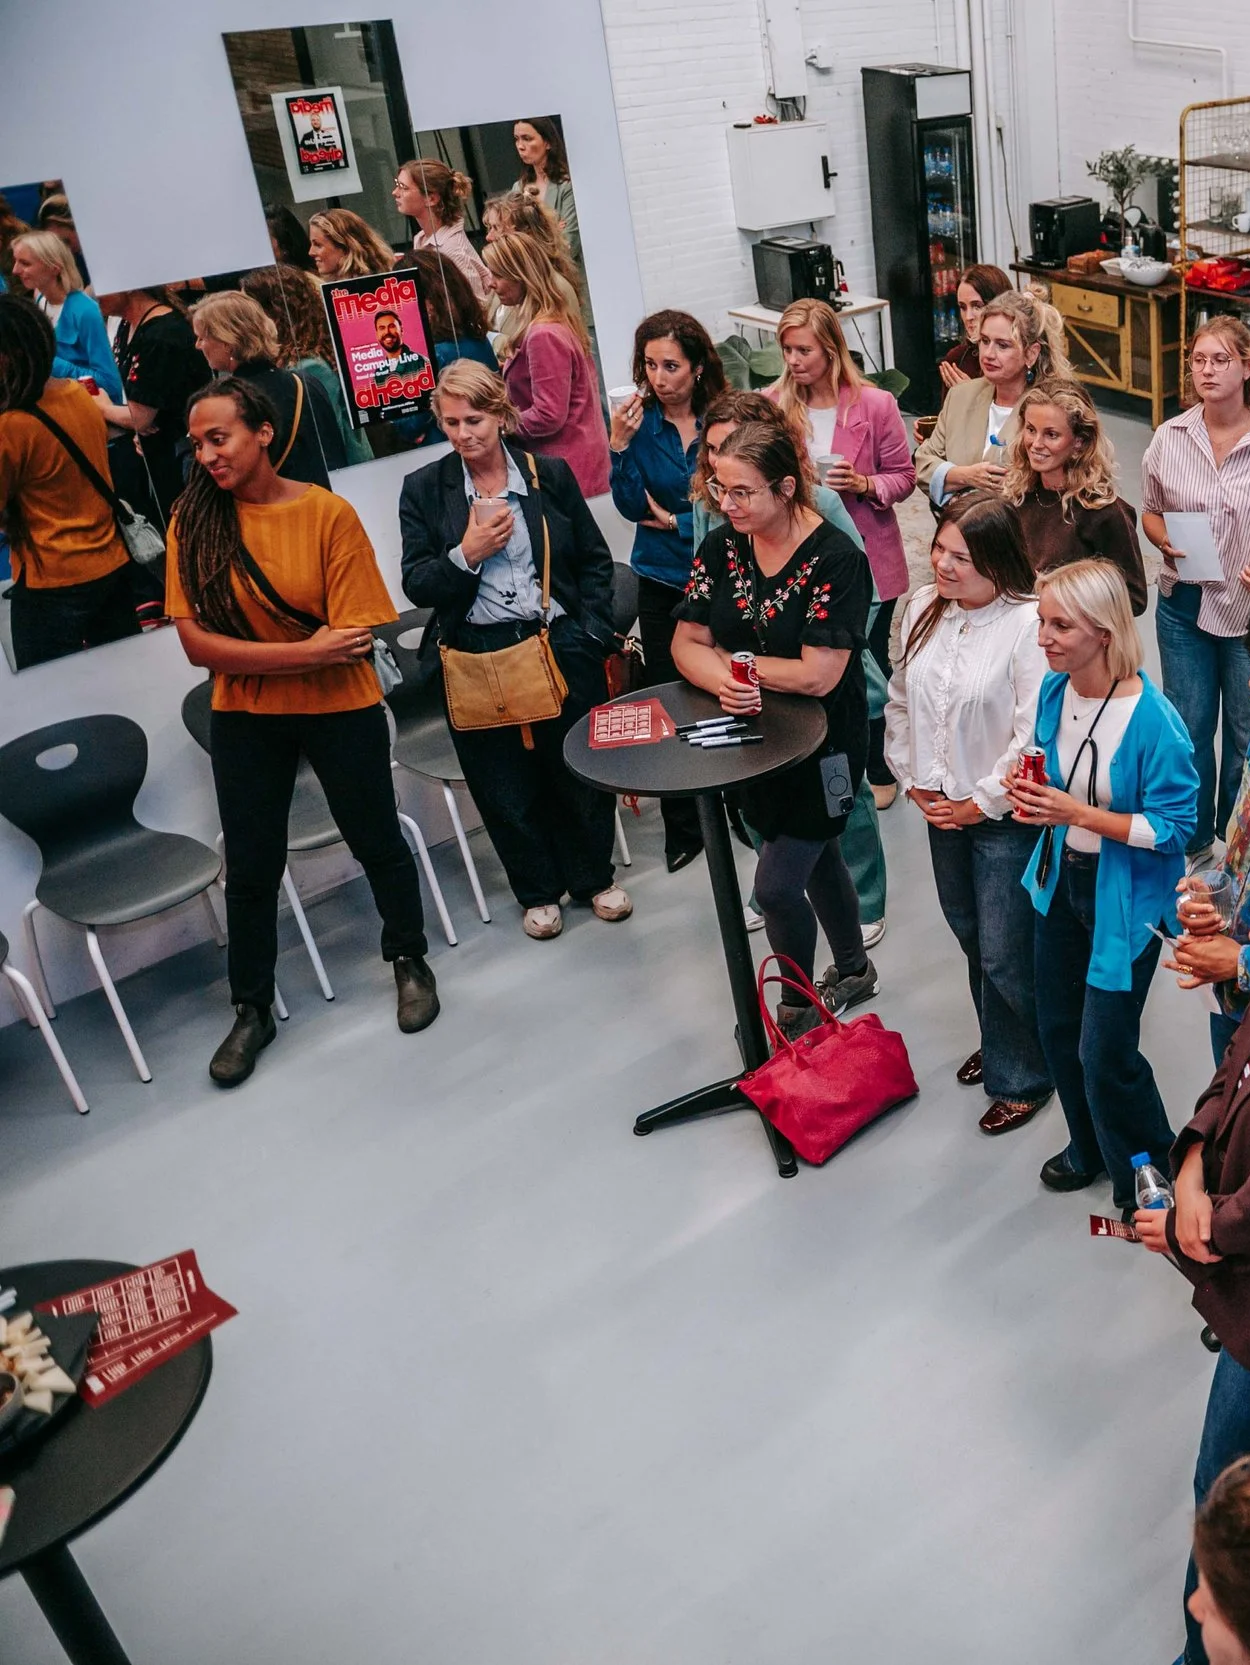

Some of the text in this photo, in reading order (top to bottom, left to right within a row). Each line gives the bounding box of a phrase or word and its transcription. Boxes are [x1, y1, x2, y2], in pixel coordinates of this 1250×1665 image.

[331, 288, 349, 297] the
[333, 277, 417, 317] media
[351, 348, 384, 362] Media
[399, 352, 419, 364] Live
[355, 362, 436, 409] ahead
